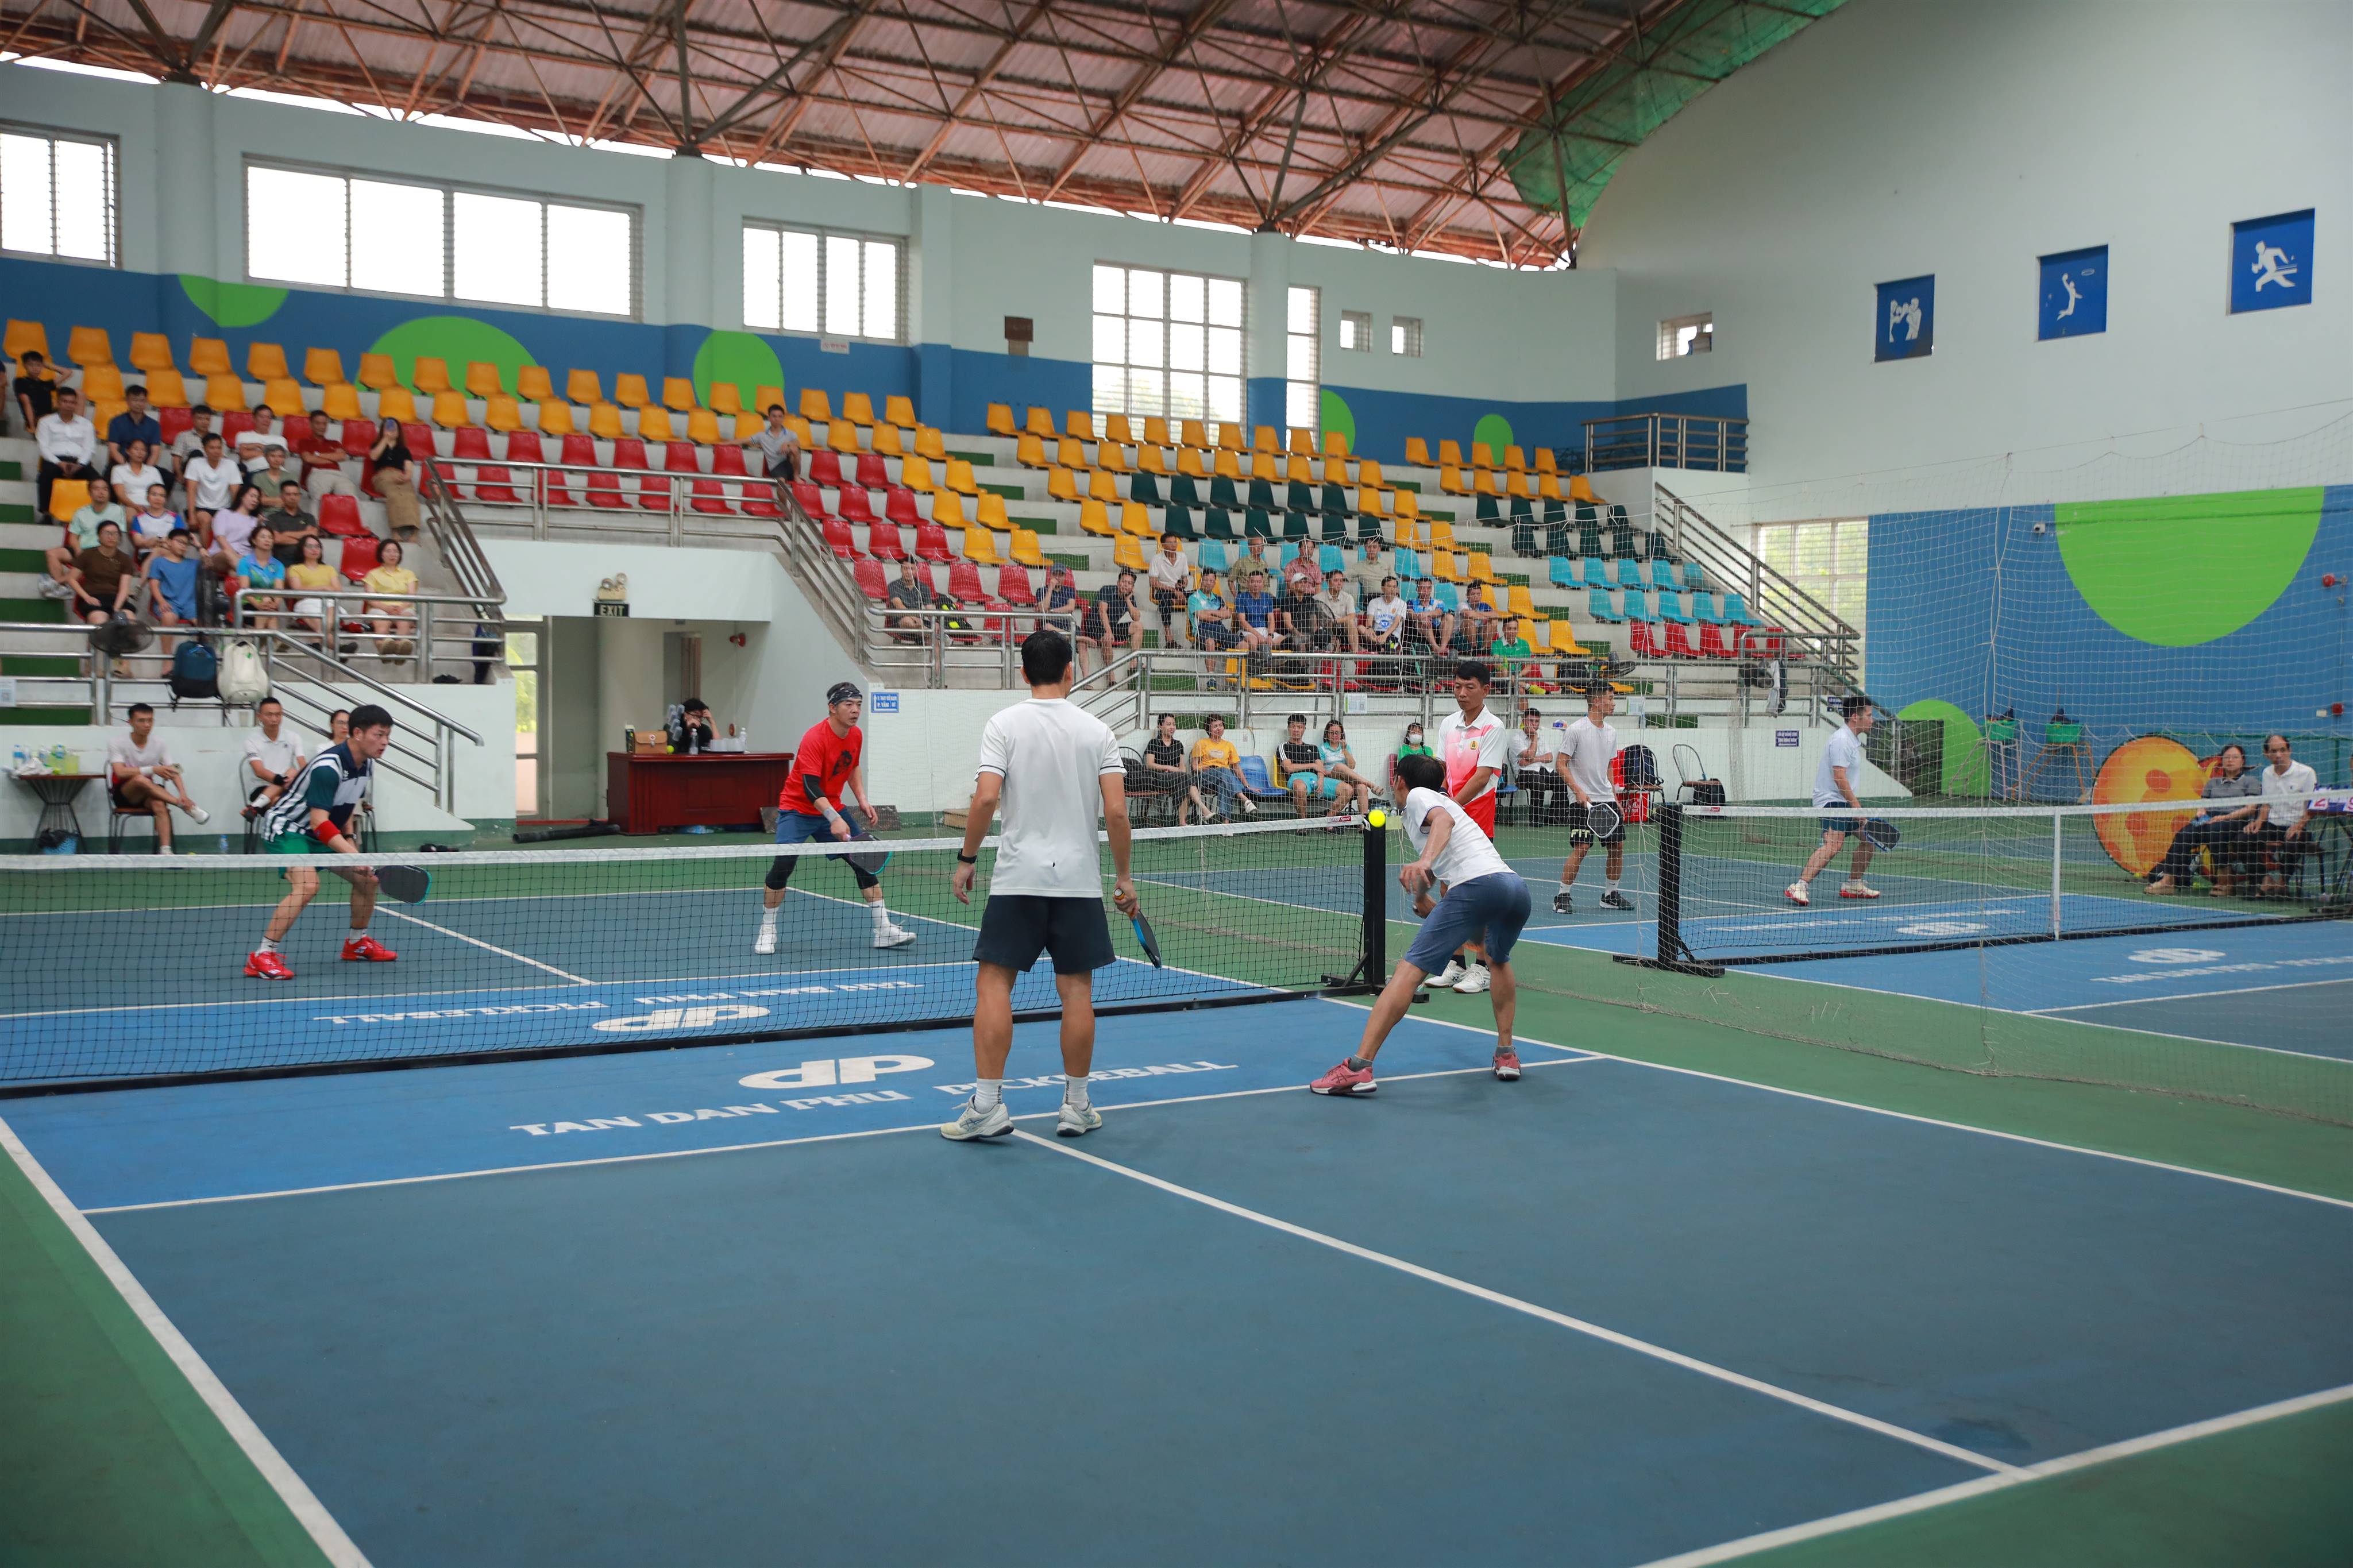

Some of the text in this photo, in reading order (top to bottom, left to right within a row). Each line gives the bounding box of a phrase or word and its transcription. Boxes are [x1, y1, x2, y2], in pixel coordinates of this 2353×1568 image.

[600, 605, 624, 616] EXIT
[1571, 829, 1590, 838] FIT
[510, 1116, 642, 1136] TAN
[645, 1103, 781, 1124] DAN
[780, 1090, 914, 1110] PHU
